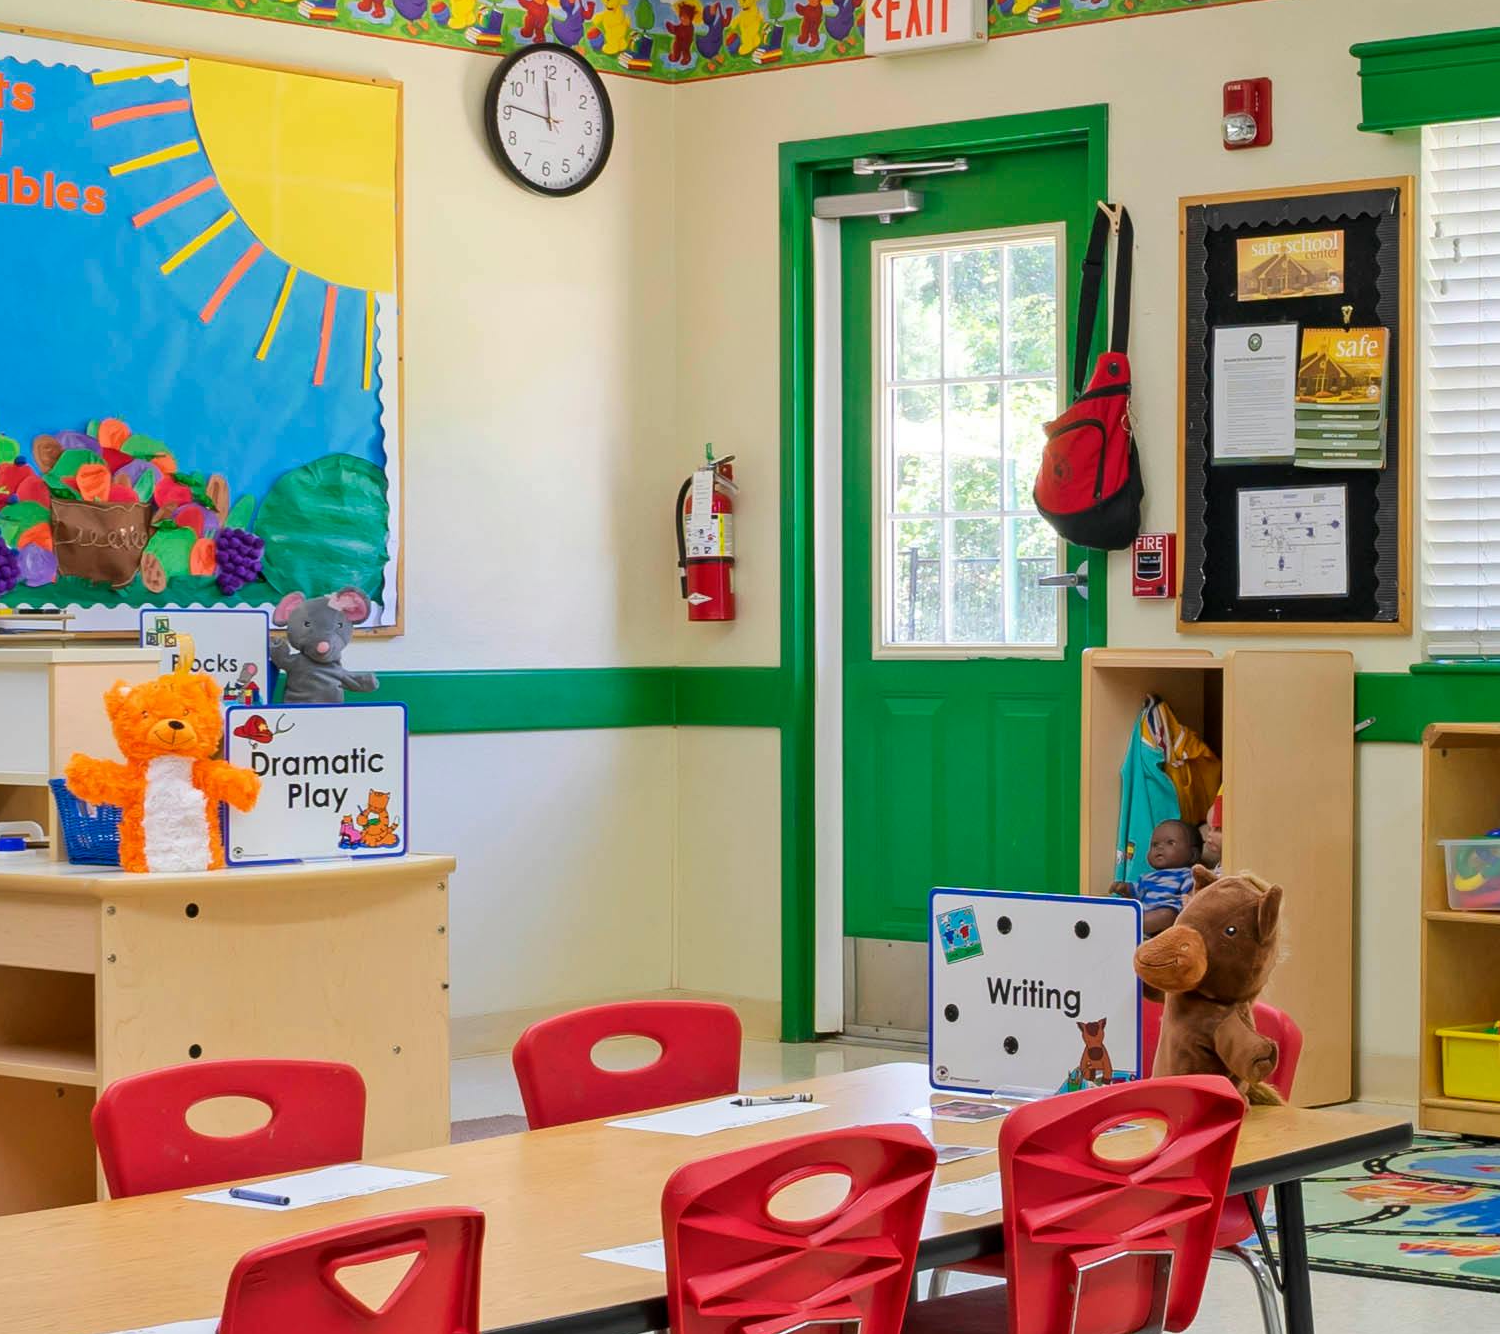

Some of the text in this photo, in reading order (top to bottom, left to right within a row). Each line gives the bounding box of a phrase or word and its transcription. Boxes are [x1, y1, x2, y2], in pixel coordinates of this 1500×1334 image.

[524, 69, 535, 84] 11
[543, 65, 557, 81] 12
[510, 81, 524, 97] 10
[565, 77, 571, 91] 1
[579, 95, 587, 110] 2
[503, 105, 512, 120] 9
[584, 121, 593, 136] 3
[508, 131, 516, 146] 8
[524, 151, 532, 167] 7
[577, 144, 585, 158] 4
[542, 161, 551, 177] 6
[562, 158, 571, 174] 5
[1251, 232, 1338, 257] safe school
[1305, 249, 1338, 260] center
[1335, 334, 1379, 358] safe
[1135, 536, 1164, 550] FIRE
[250, 747, 385, 777] Dramatic
[287, 784, 349, 813] Play
[986, 977, 1082, 1018] Writing
